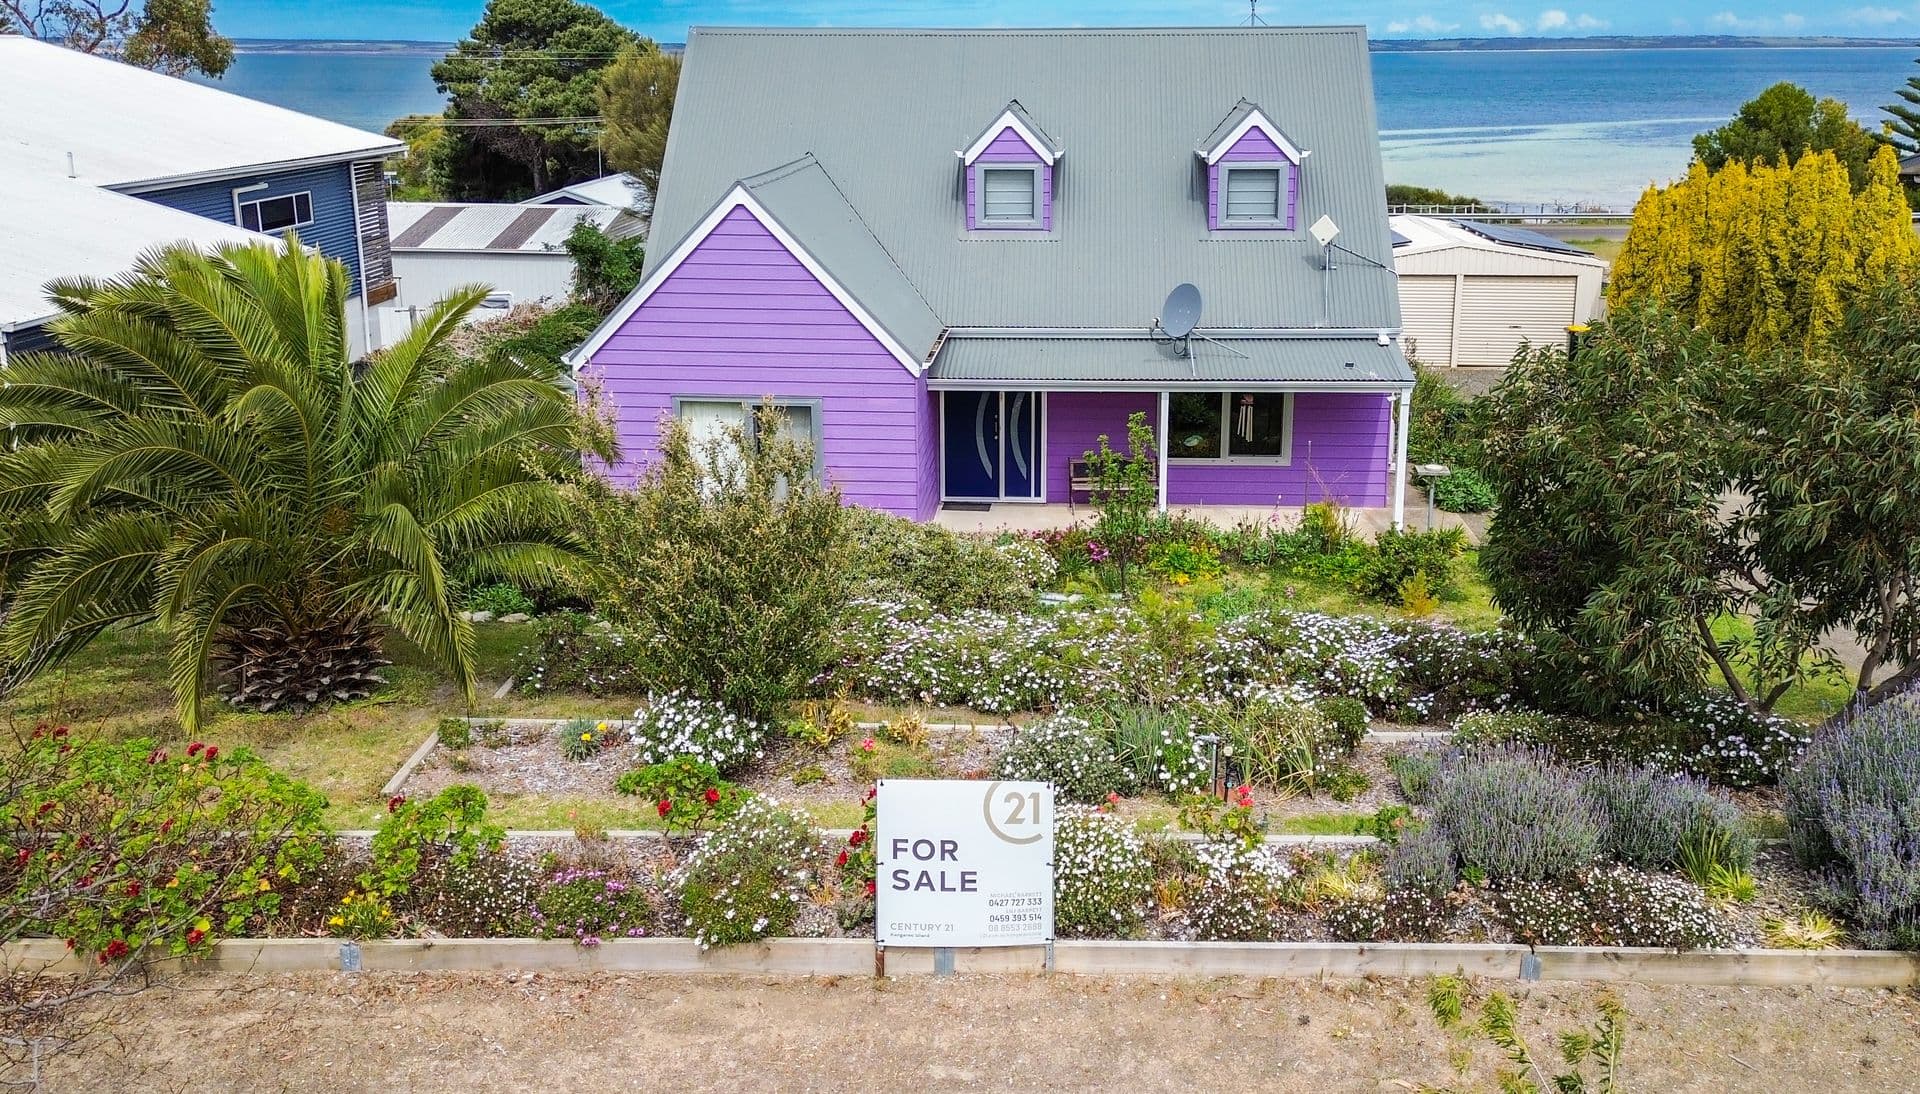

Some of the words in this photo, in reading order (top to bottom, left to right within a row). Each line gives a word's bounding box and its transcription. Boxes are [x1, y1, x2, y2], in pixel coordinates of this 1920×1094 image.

[892, 839, 958, 861] FOR
[892, 869, 978, 892] SALE
[988, 899, 1009, 907] 0427
[1011, 898, 1026, 906] 727
[1026, 897, 1042, 906] 333
[989, 914, 1010, 922] 0459
[1011, 914, 1027, 922] 393
[1028, 913, 1042, 921] 514
[890, 922, 942, 931] CENTURY
[944, 923, 954, 932] 21
